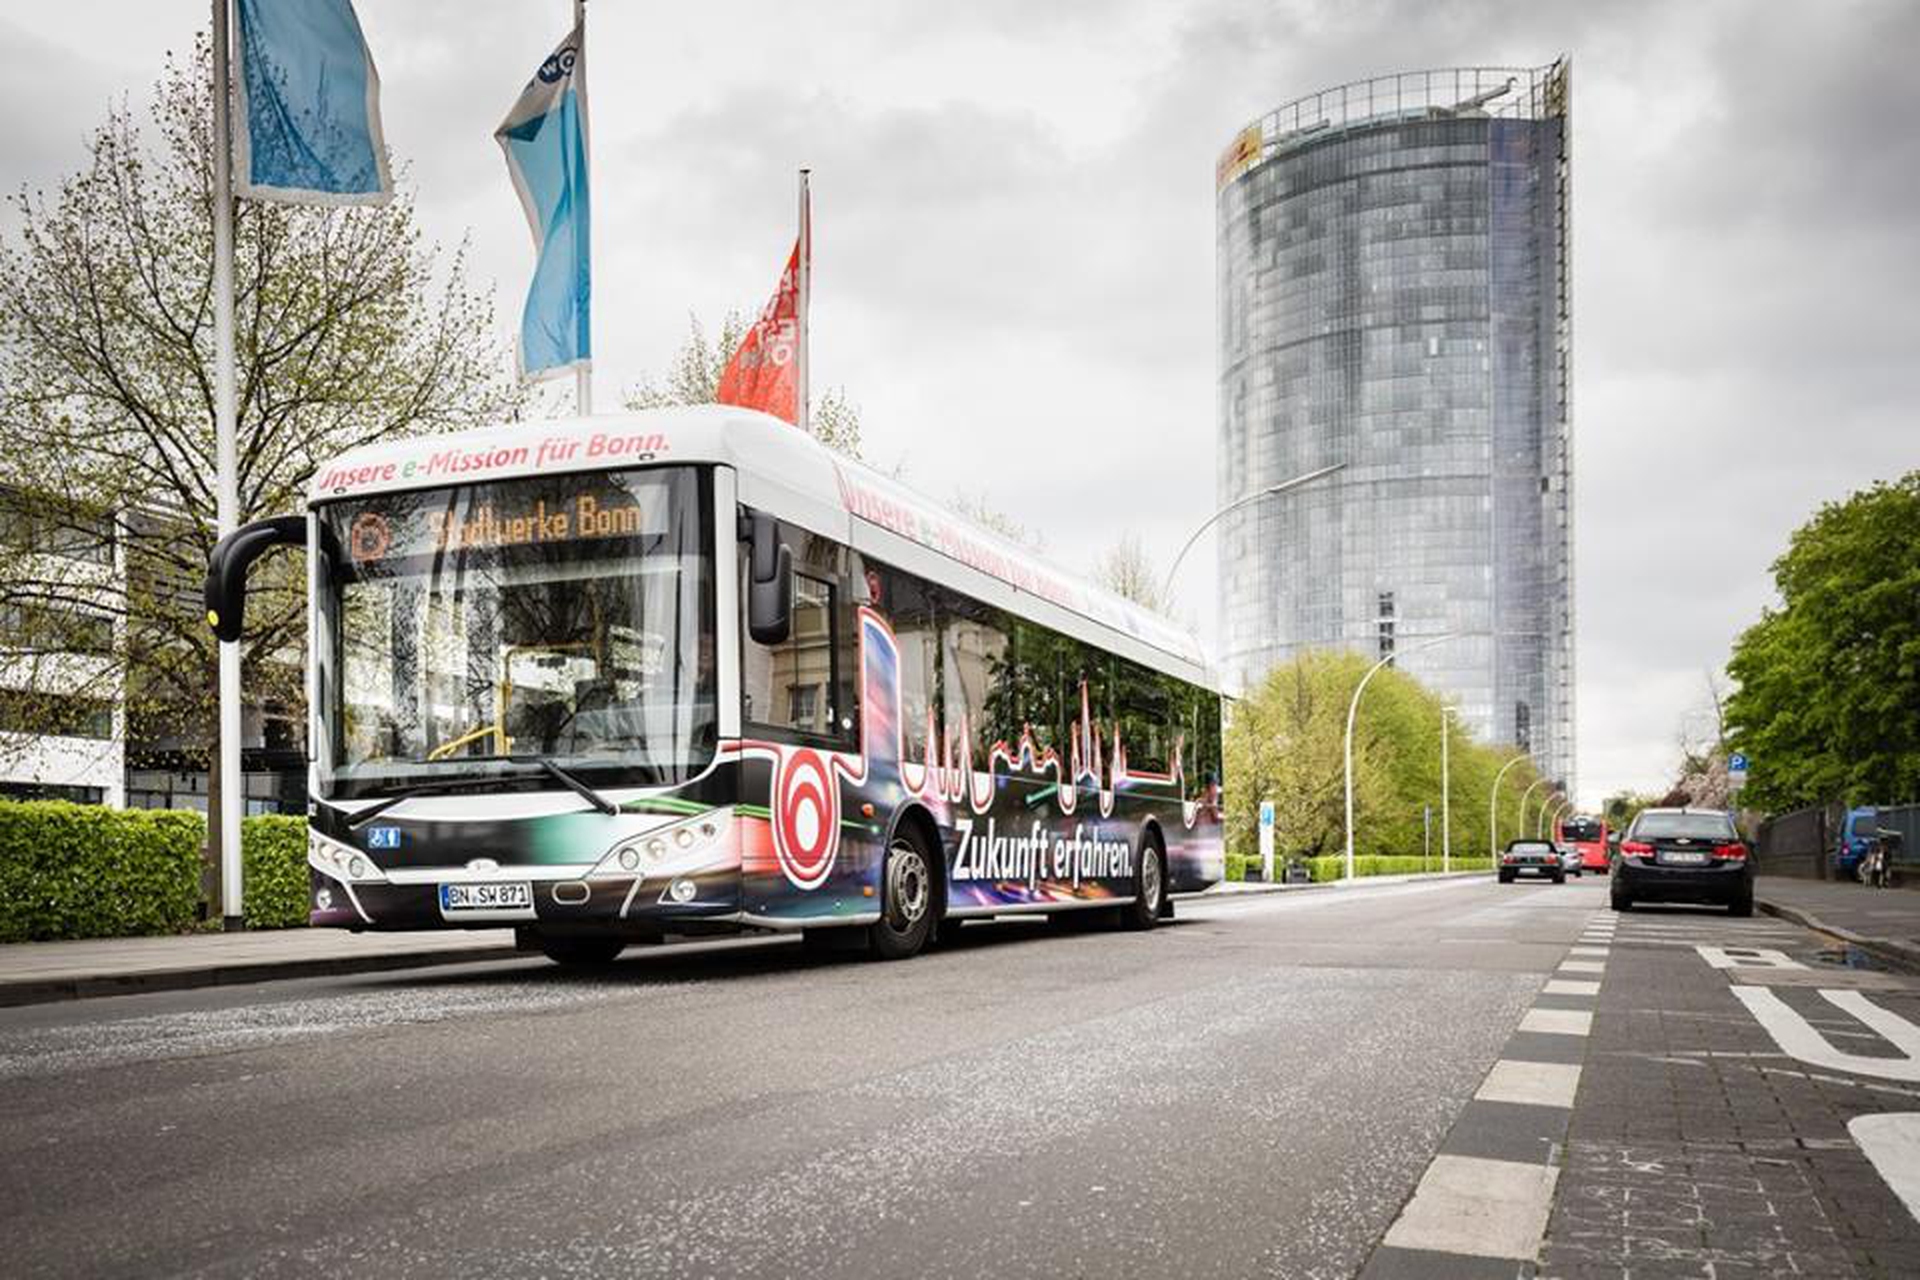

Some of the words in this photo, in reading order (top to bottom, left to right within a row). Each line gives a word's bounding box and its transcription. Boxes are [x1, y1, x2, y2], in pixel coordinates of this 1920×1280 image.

[319, 462, 397, 490] Unsere
[402, 447, 529, 478] e-Mission
[535, 438, 581, 468] für
[586, 433, 670, 457] Bonn.
[577, 495, 642, 535] Bonn
[952, 817, 1049, 891] Zukunft
[1054, 823, 1133, 889] erfahren.
[449, 888, 469, 904] BN
[478, 887, 497, 903] SW
[499, 886, 527, 903] 871
